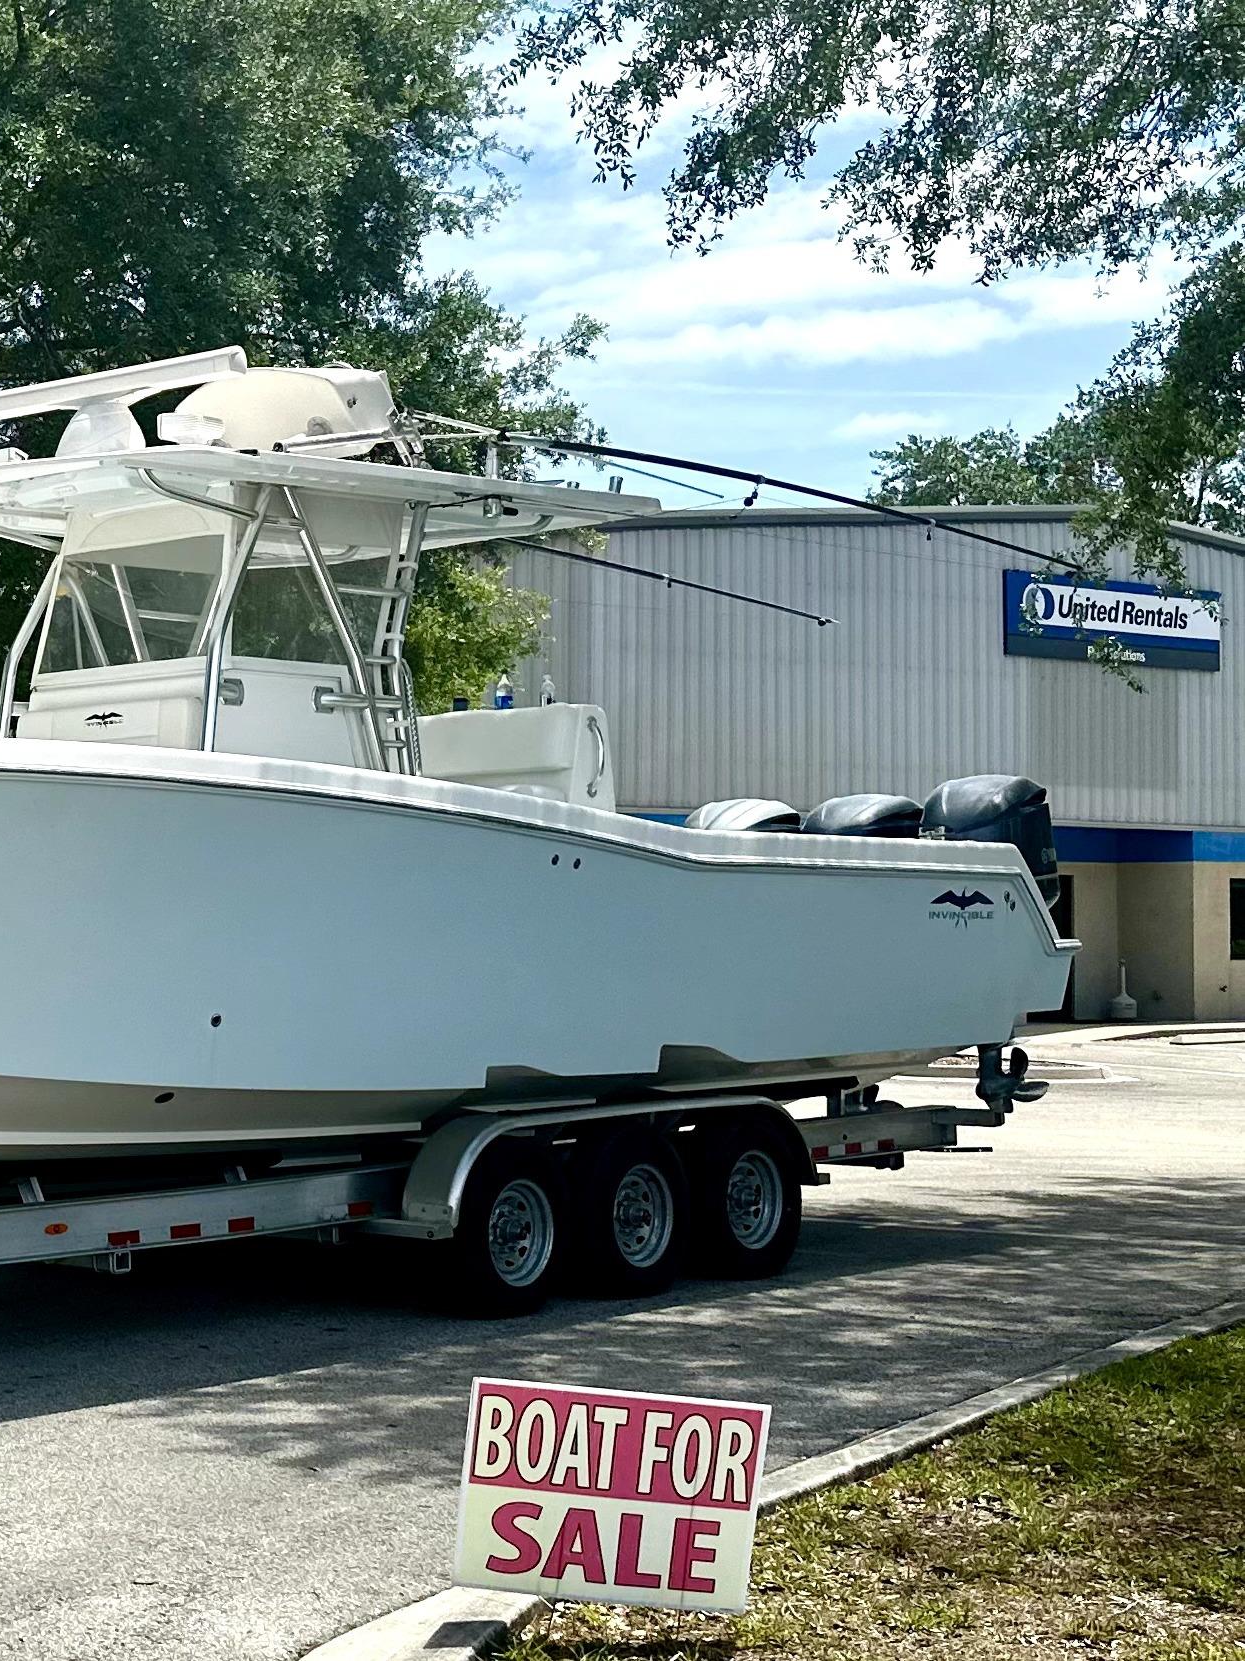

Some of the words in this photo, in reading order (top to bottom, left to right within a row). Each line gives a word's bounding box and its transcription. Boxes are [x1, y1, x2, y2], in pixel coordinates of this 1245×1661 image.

[1058, 594, 1120, 623] United
[1121, 601, 1188, 629] Rentals
[472, 1393, 629, 1490] BOAT
[636, 1409, 754, 1503] FOR
[485, 1501, 721, 1594] SALE
